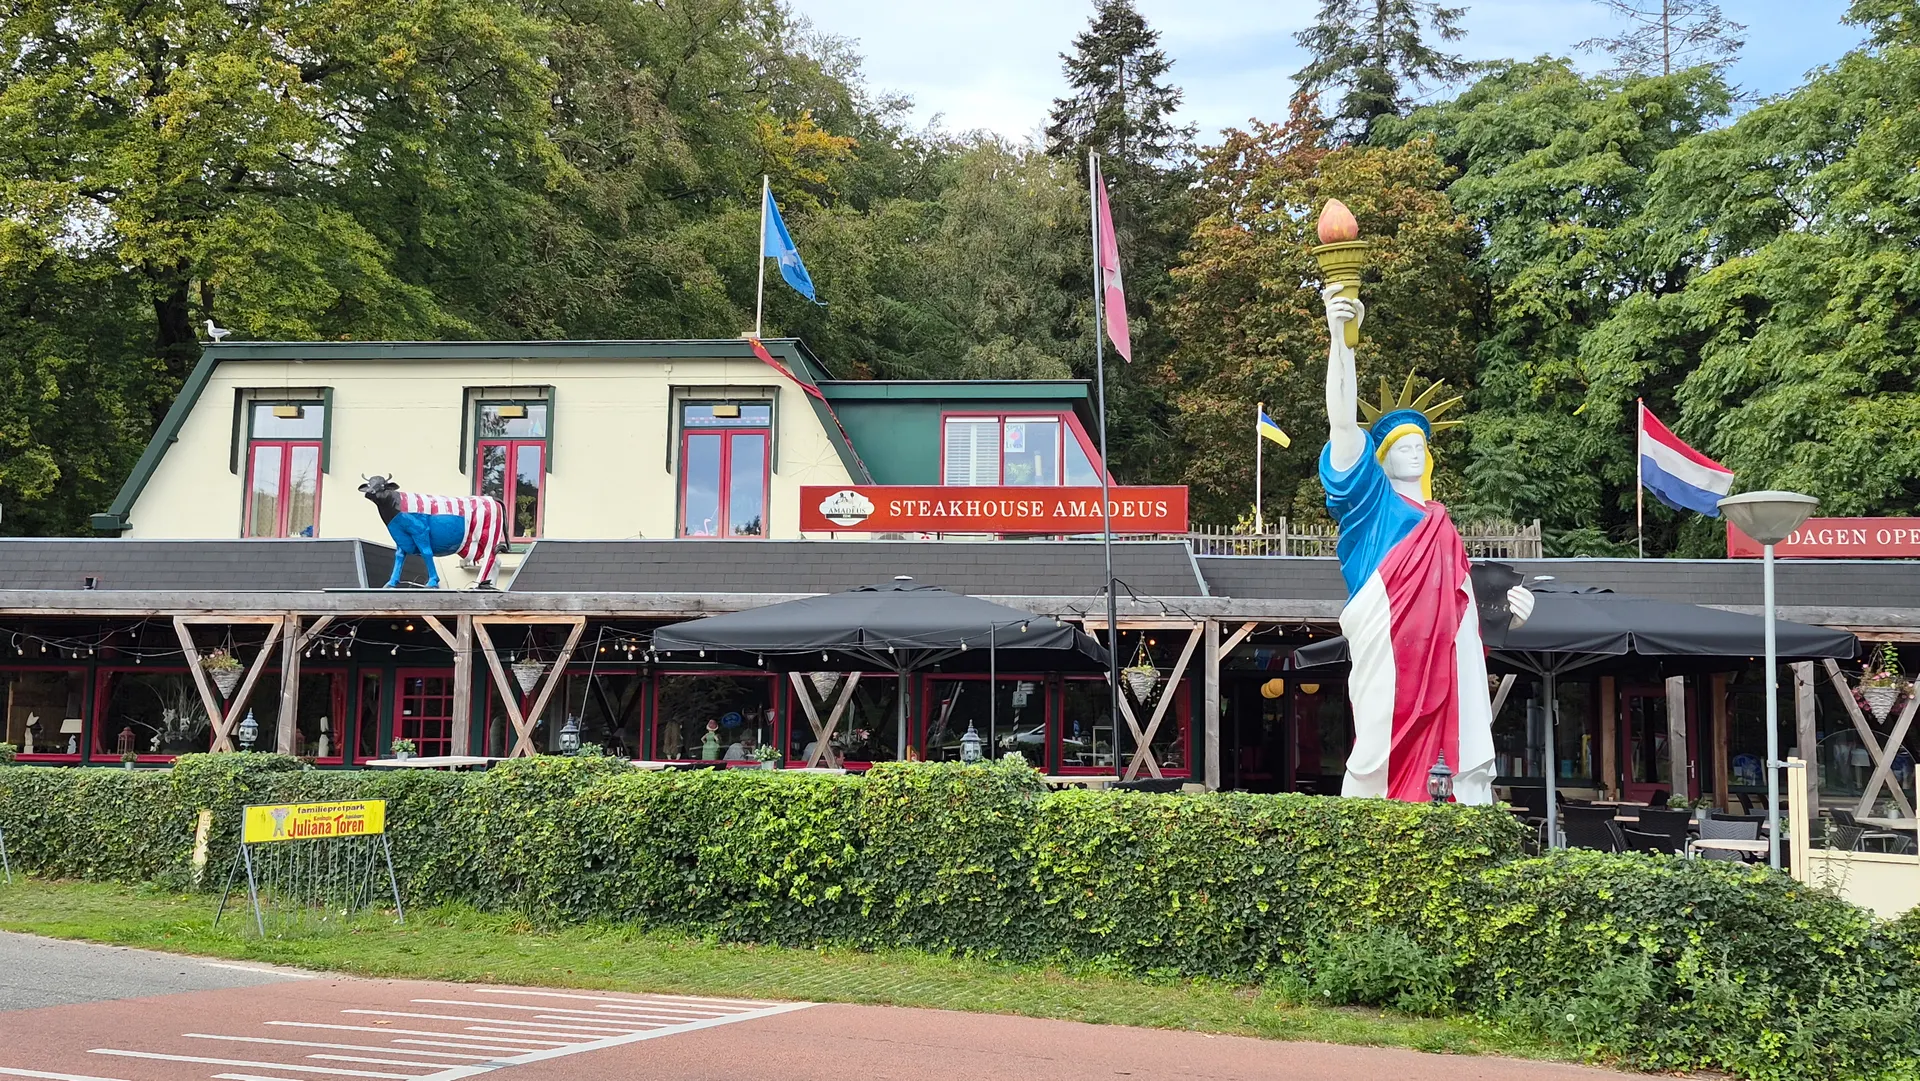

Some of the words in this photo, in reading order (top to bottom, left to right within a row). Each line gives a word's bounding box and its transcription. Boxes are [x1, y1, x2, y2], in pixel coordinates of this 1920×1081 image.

[889, 500, 1045, 518] STEAKHOUSE
[1053, 500, 1168, 518] AMADEUS
[1786, 528, 1867, 545] DAGEN
[297, 803, 365, 815] familiepretpark
[287, 817, 332, 838] Juliana
[333, 813, 364, 835] Toren
